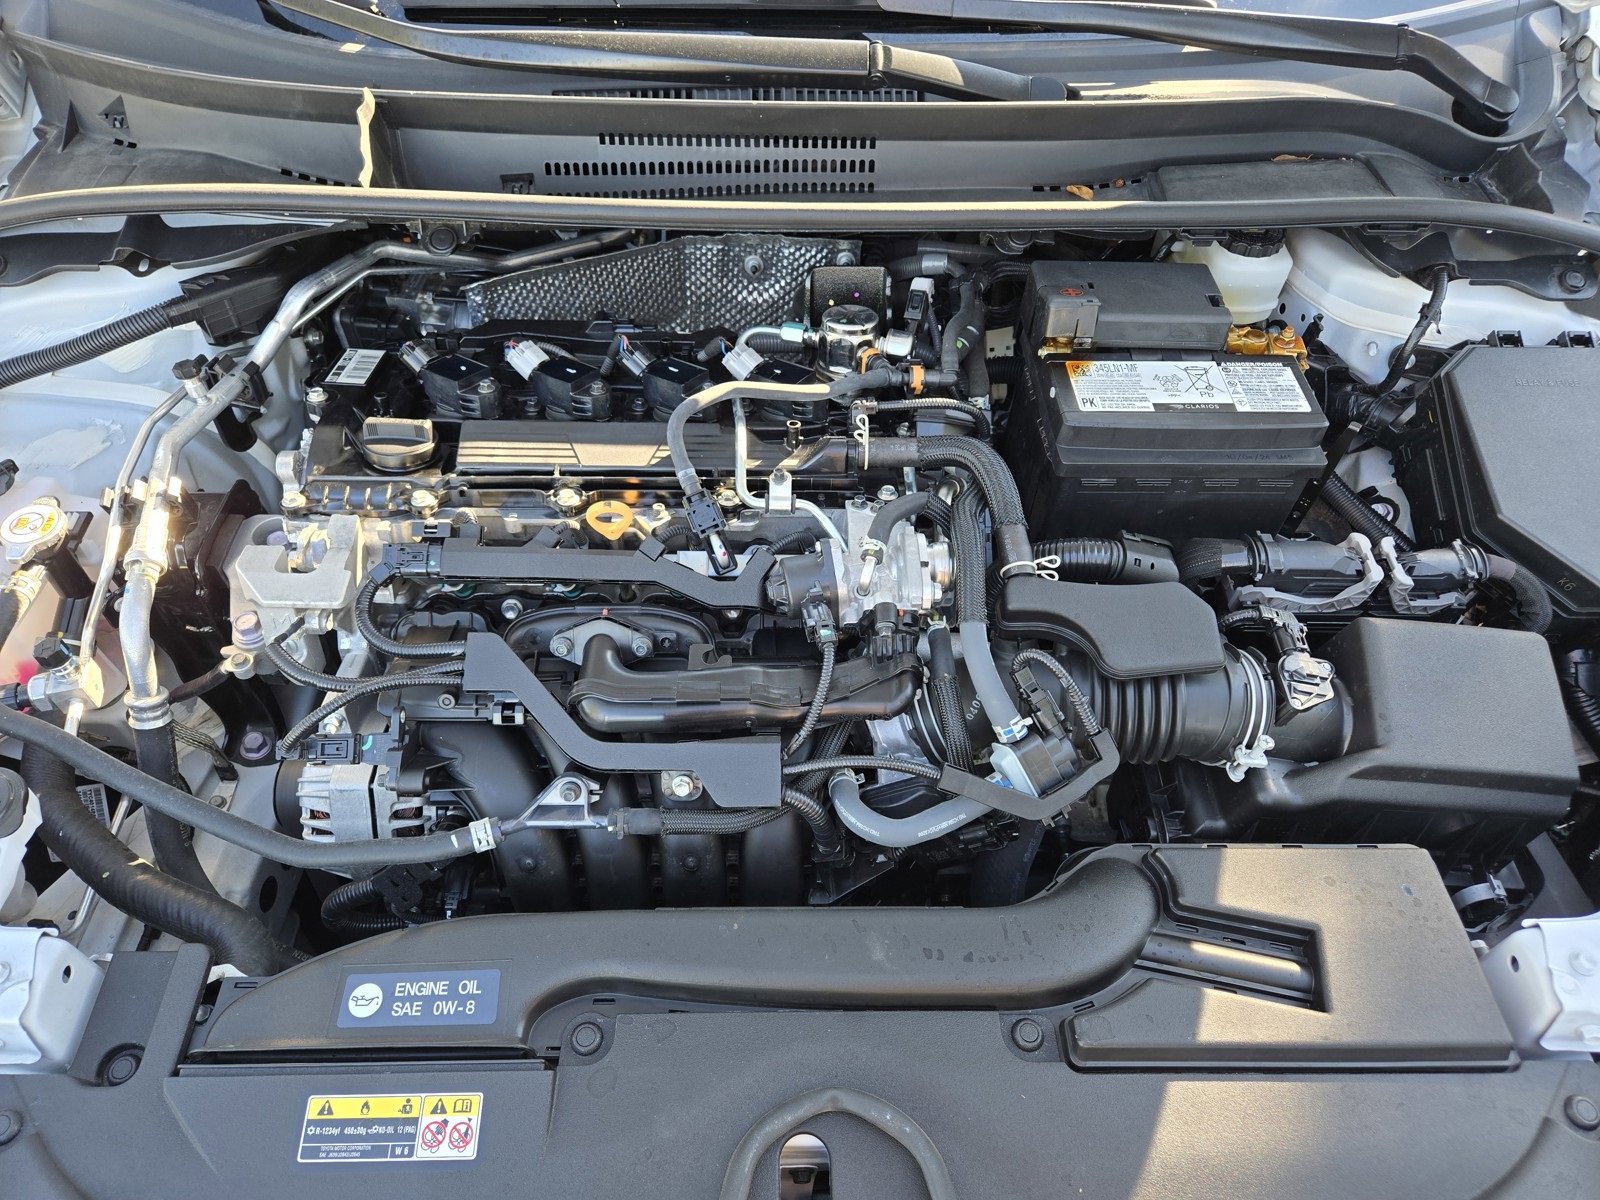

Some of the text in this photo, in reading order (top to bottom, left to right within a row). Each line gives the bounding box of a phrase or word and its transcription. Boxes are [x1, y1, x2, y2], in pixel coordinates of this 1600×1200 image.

[1199, 390, 1214, 398] Pb
[1081, 397, 1097, 408] PK
[394, 979, 482, 997] ENGINE OIL
[391, 1000, 475, 1017] SAE 0W-8
[315, 1126, 340, 1136] R-1234yf
[344, 1126, 367, 1136] 450±30g
[397, 1125, 403, 1133] 12
[395, 1146, 409, 1155] W 6
